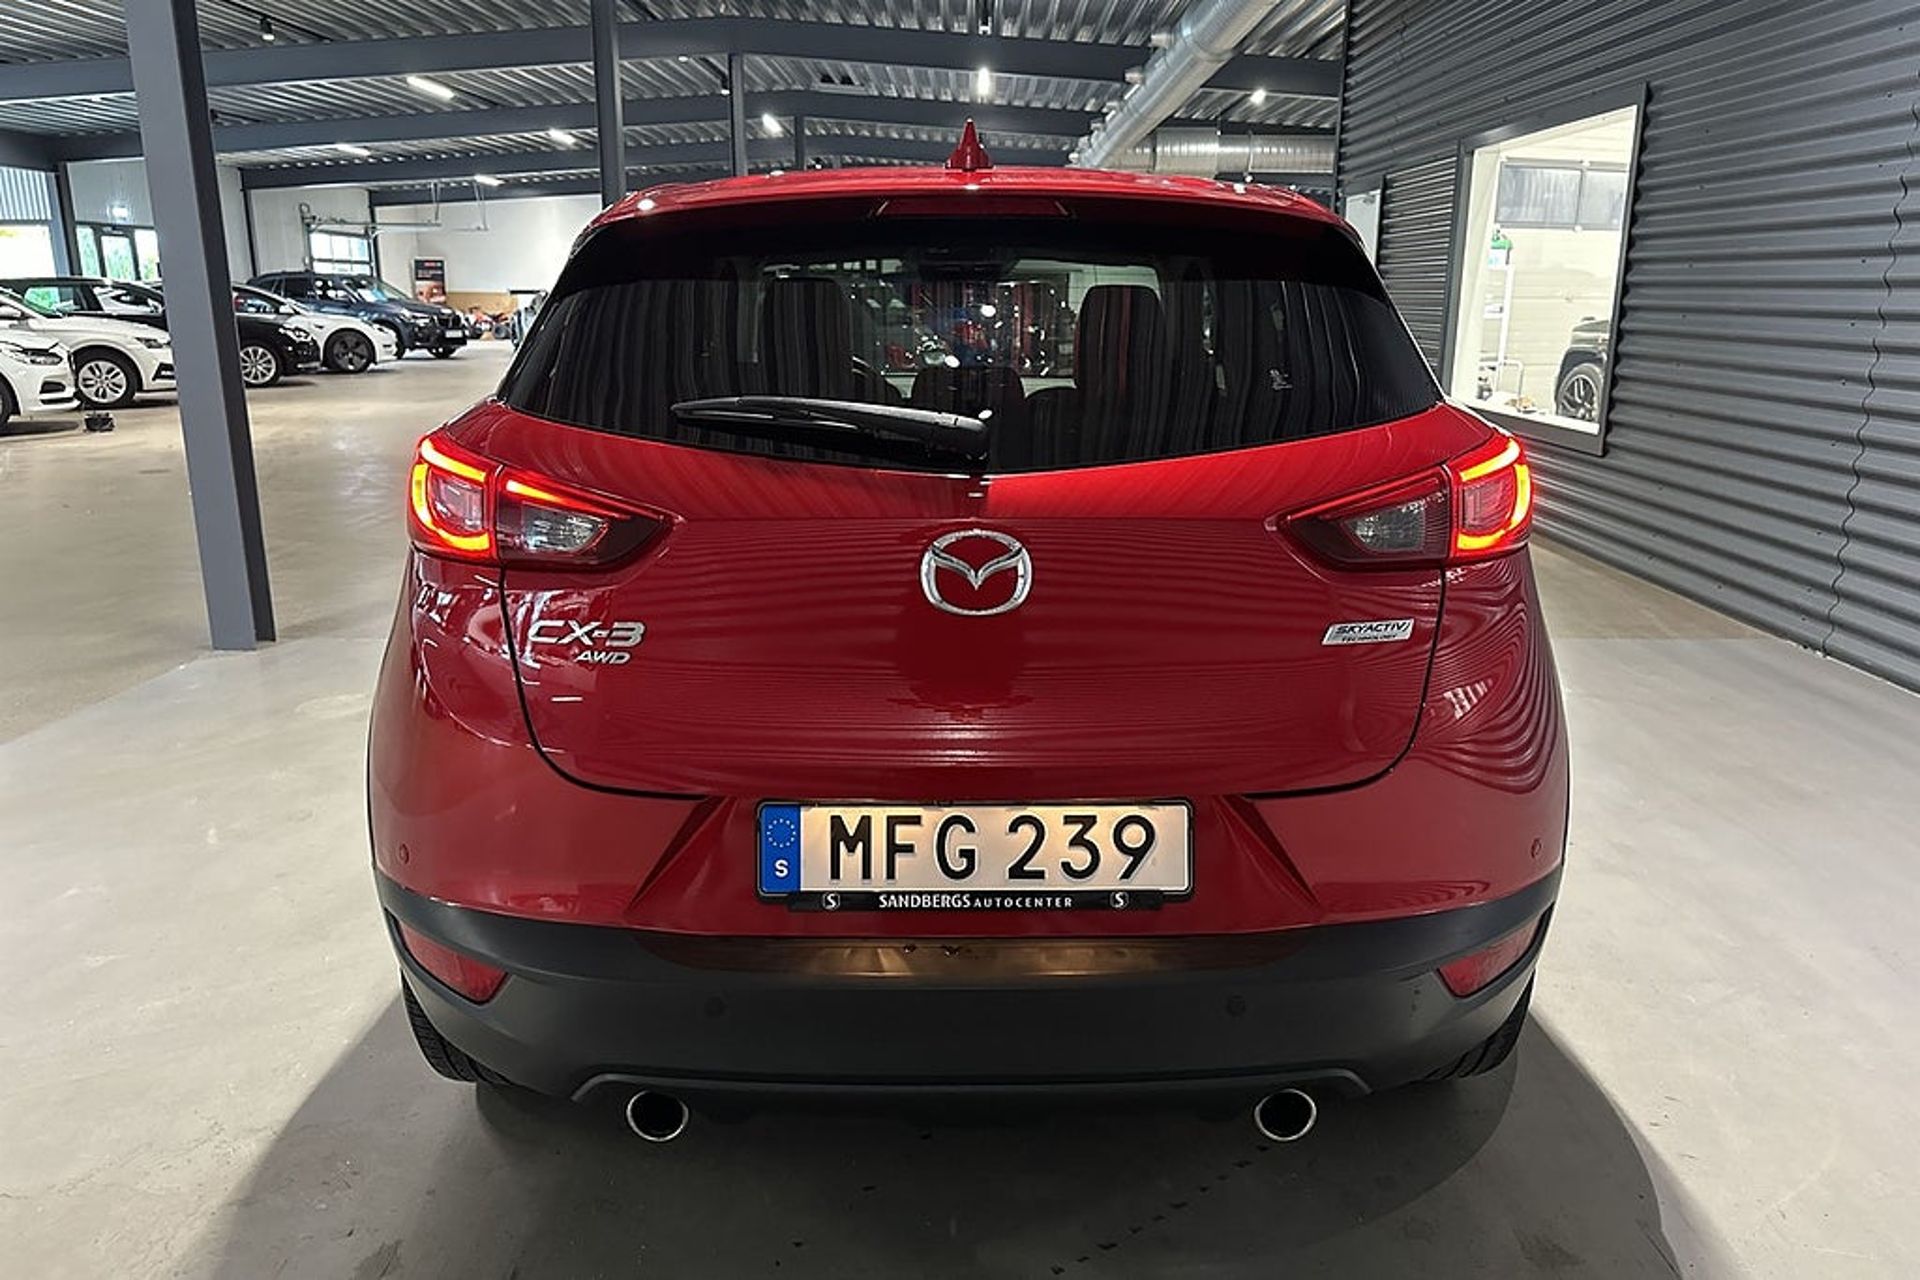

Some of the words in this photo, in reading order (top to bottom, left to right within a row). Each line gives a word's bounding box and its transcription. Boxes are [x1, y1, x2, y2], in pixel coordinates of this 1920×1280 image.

[528, 620, 645, 647] CX-3
[1335, 622, 1407, 634] SKYACTIV
[575, 651, 631, 664] AWD
[829, 814, 977, 880] MFG
[1006, 814, 1156, 880] 239
[774, 860, 788, 878] S
[878, 894, 971, 908] SANDBERGS
[973, 897, 1073, 908] AUTOCENTER
